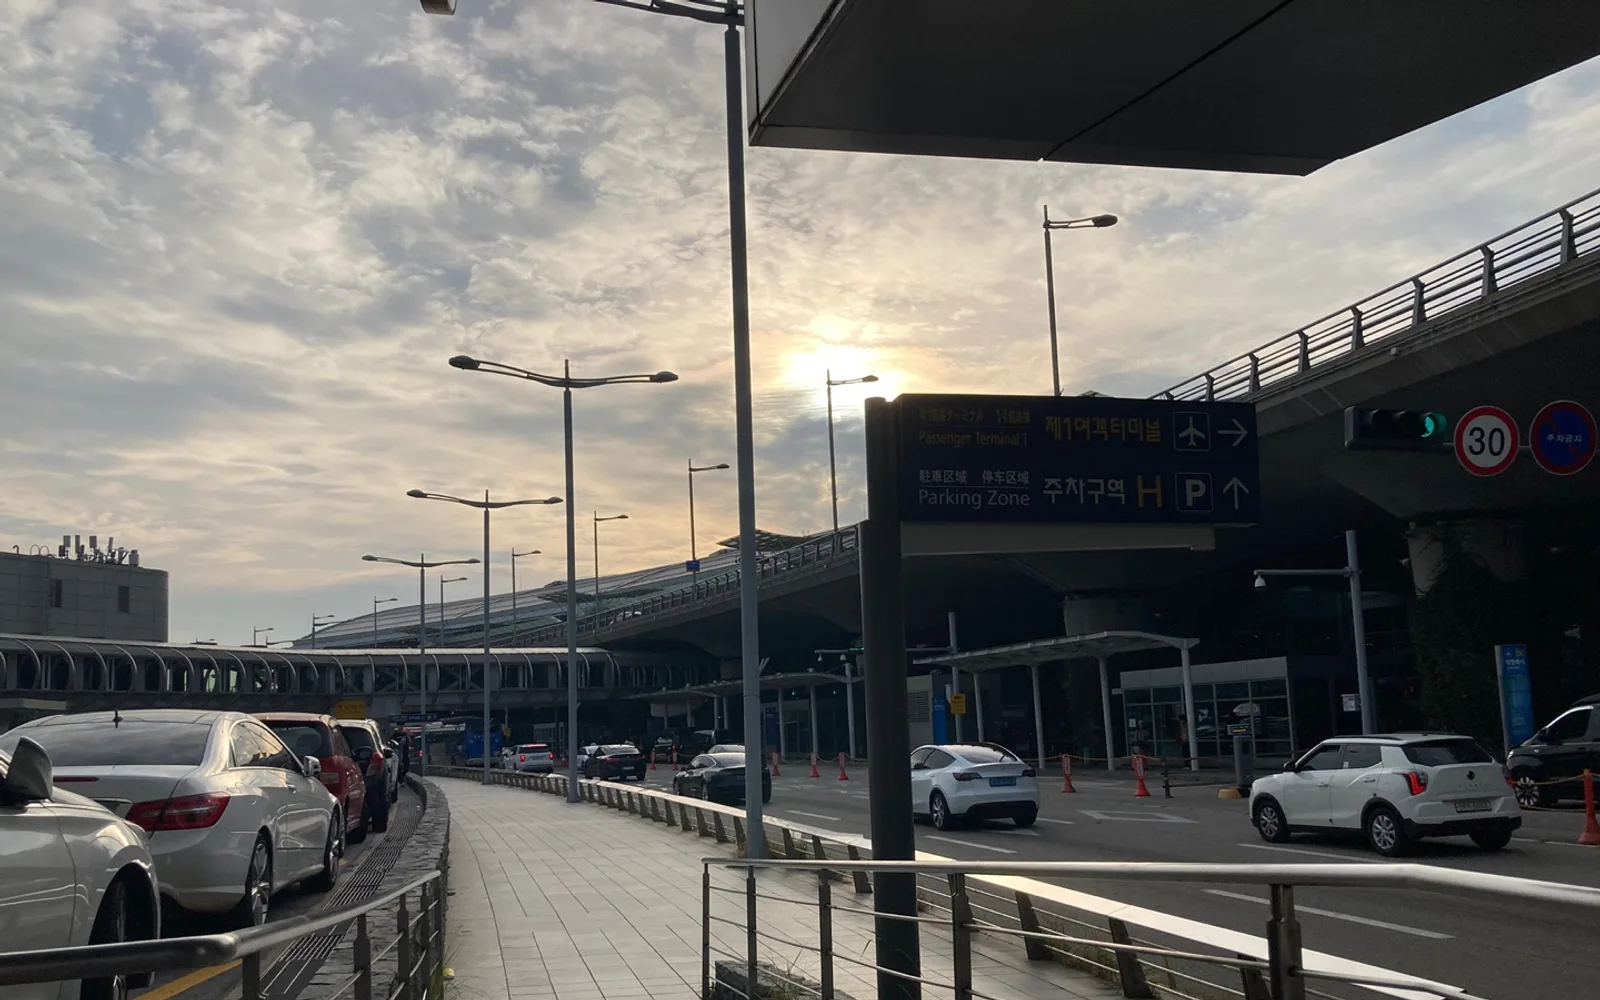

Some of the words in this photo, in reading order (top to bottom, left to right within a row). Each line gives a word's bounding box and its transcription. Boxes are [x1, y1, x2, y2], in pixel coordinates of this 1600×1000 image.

[919, 430, 971, 447] Passenger
[974, 431, 1019, 446] Terminal
[1021, 432, 1028, 446] 1
[1045, 416, 1161, 443] 제1여객터미널
[1468, 427, 1505, 456] 30
[1546, 433, 1582, 444] 주차금지
[918, 488, 983, 510] Parking
[987, 489, 1031, 507] Zone
[1043, 476, 1125, 505] 주차구역
[1136, 474, 1163, 508] H
[1185, 479, 1206, 507] P
